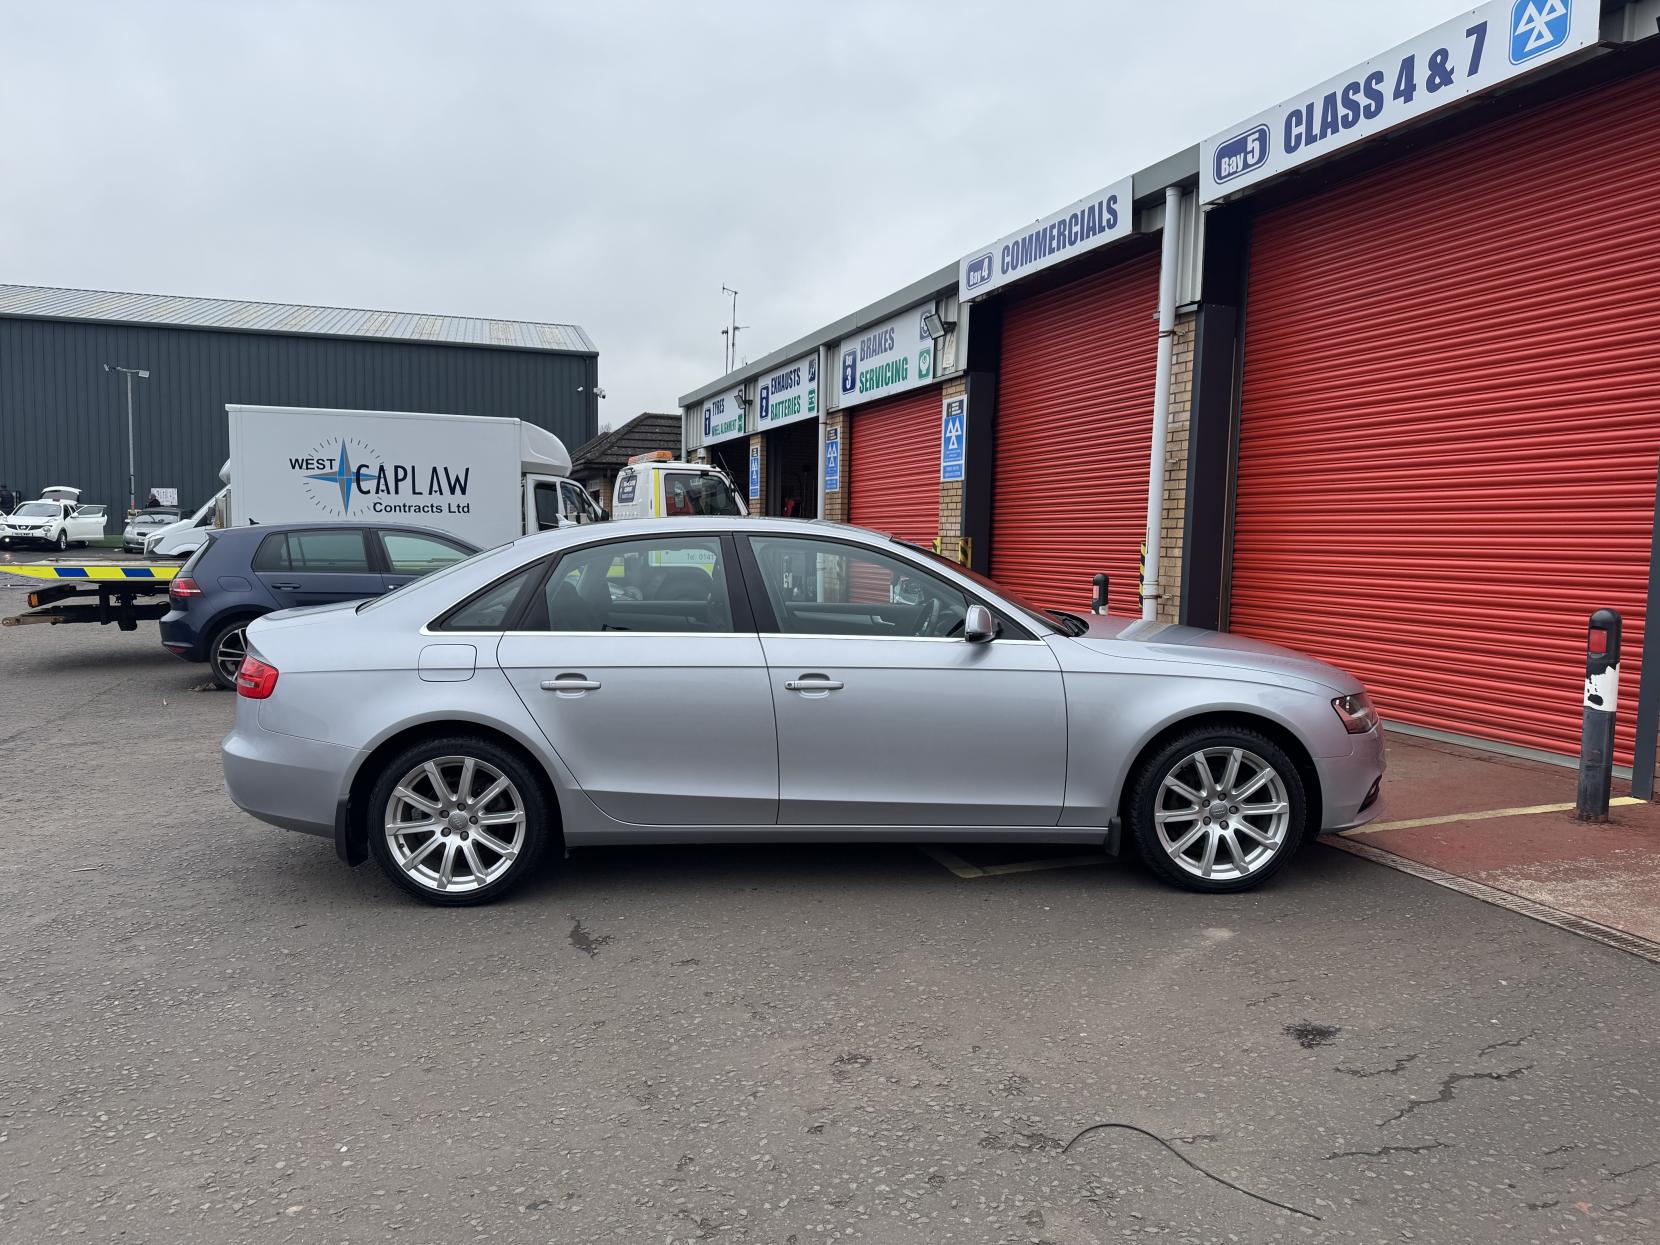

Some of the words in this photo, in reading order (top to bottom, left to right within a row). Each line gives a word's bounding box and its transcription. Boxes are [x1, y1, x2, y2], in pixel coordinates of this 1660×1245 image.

[1284, 71, 1384, 155] CLASS
[1393, 53, 1417, 105] 4
[1425, 47, 1455, 94] &
[1465, 20, 1488, 78] 7
[1221, 153, 1244, 177] Bay
[1246, 132, 1260, 165] 5
[1001, 194, 1118, 275] COMMERCIALS
[969, 271, 982, 284] Bay
[981, 258, 989, 279] 4
[860, 326, 895, 362] BRAKES
[771, 367, 801, 395] EXHAUSTS
[845, 367, 852, 389] 3
[859, 356, 909, 394] SERVICING
[712, 397, 725, 417] TYRES
[761, 400, 767, 417] 2
[770, 395, 801, 421] BATTERIES
[289, 458, 336, 471] WEST
[355, 463, 470, 496] CAPLAW
[373, 501, 443, 514] Contracts
[448, 502, 470, 514] Ltd
